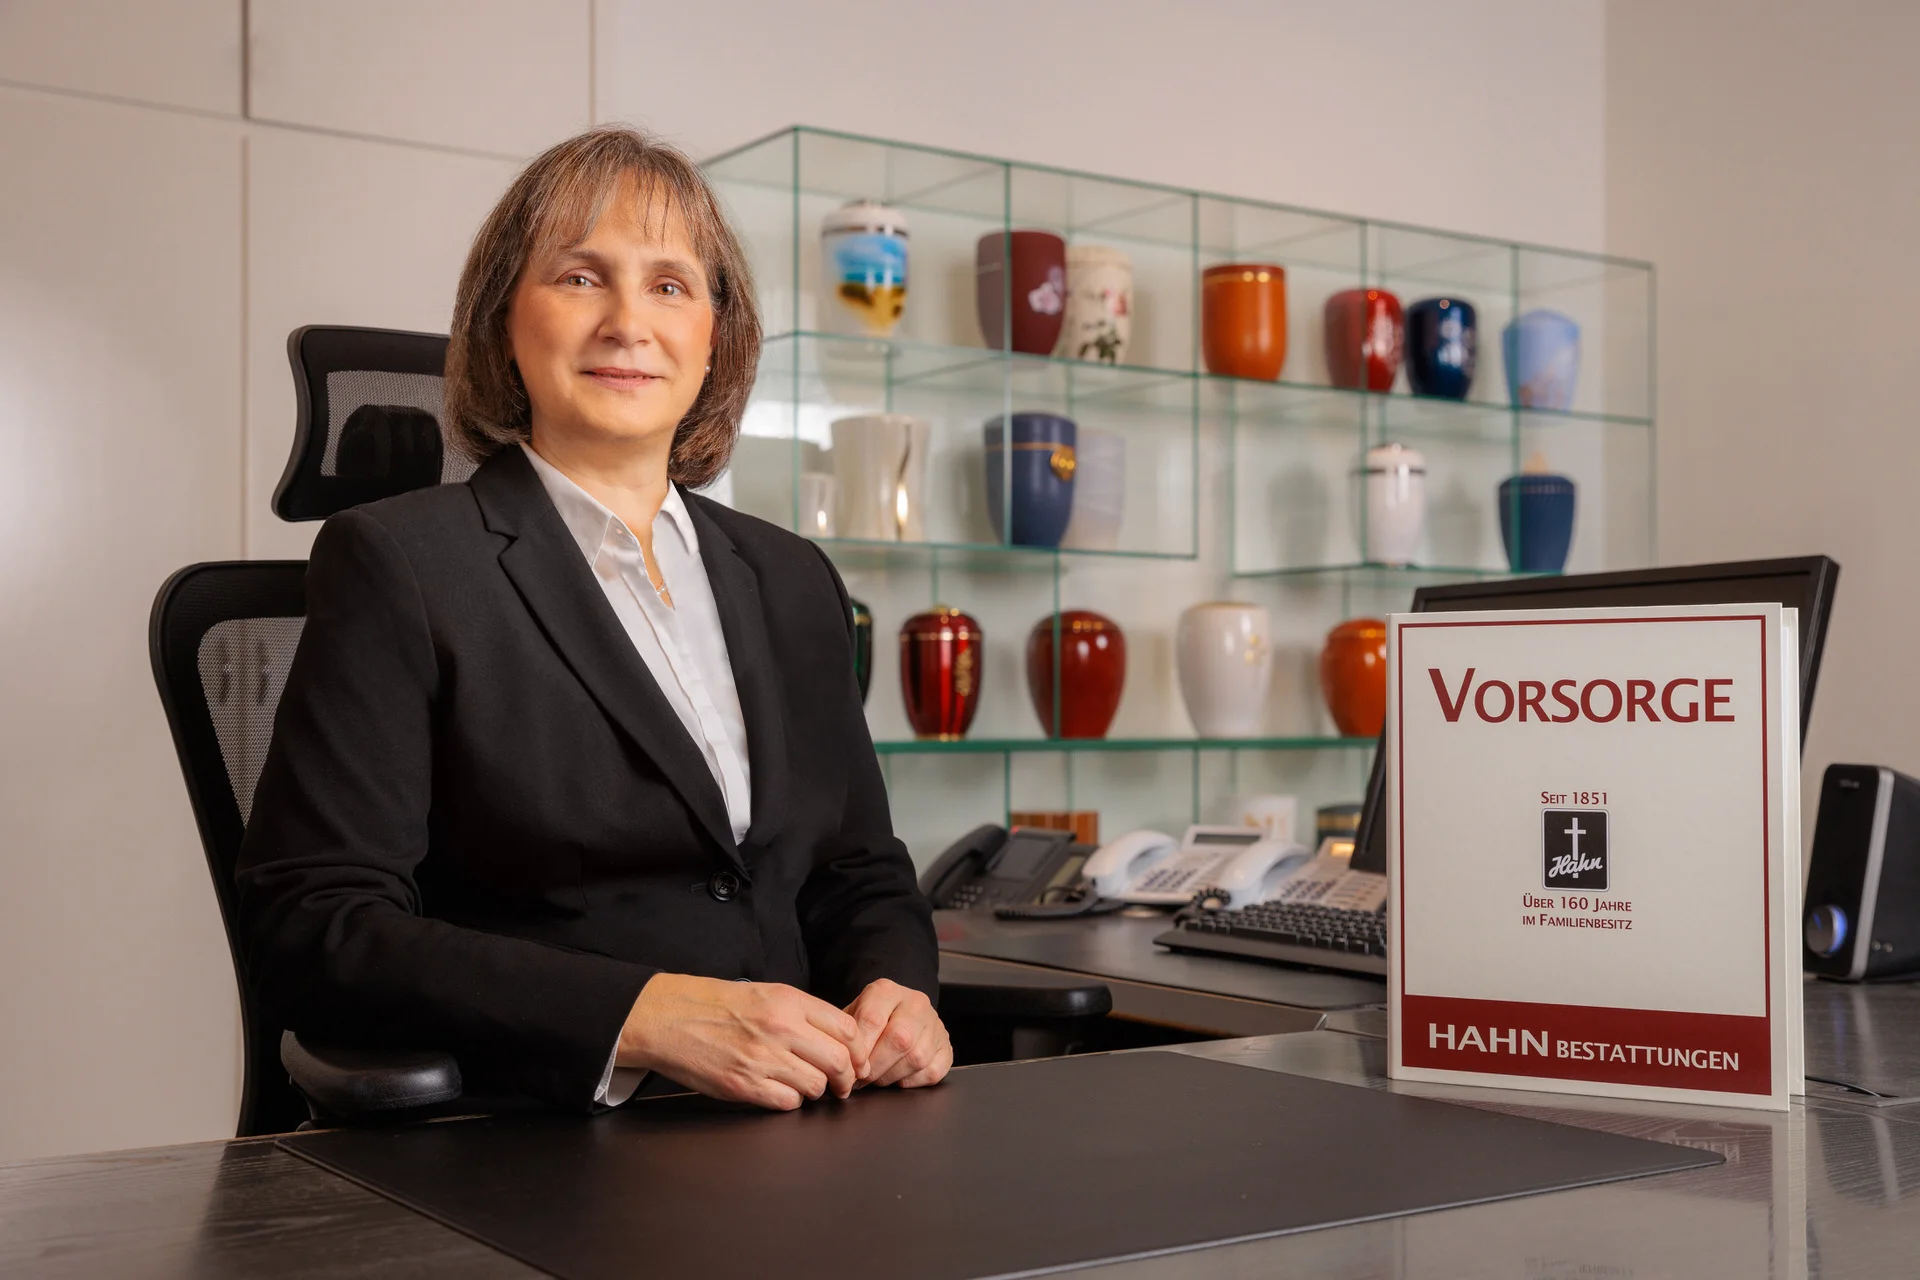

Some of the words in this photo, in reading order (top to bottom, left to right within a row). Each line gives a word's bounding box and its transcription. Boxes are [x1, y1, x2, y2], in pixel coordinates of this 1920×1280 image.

[1428, 668, 1735, 723] VORSORGE
[1541, 791, 1567, 804] SEIT
[1573, 792, 1607, 805] 1851
[1548, 853, 1603, 878] Hahn
[1523, 893, 1554, 908] ÜBER
[1561, 896, 1588, 910] 160
[1593, 898, 1632, 912] JAHRE
[1522, 915, 1535, 926] IM
[1539, 914, 1632, 930] FAMILIENBESITZ
[1428, 1023, 1549, 1057] HAHN
[1556, 1040, 1739, 1071] BESTATTUNGEN
